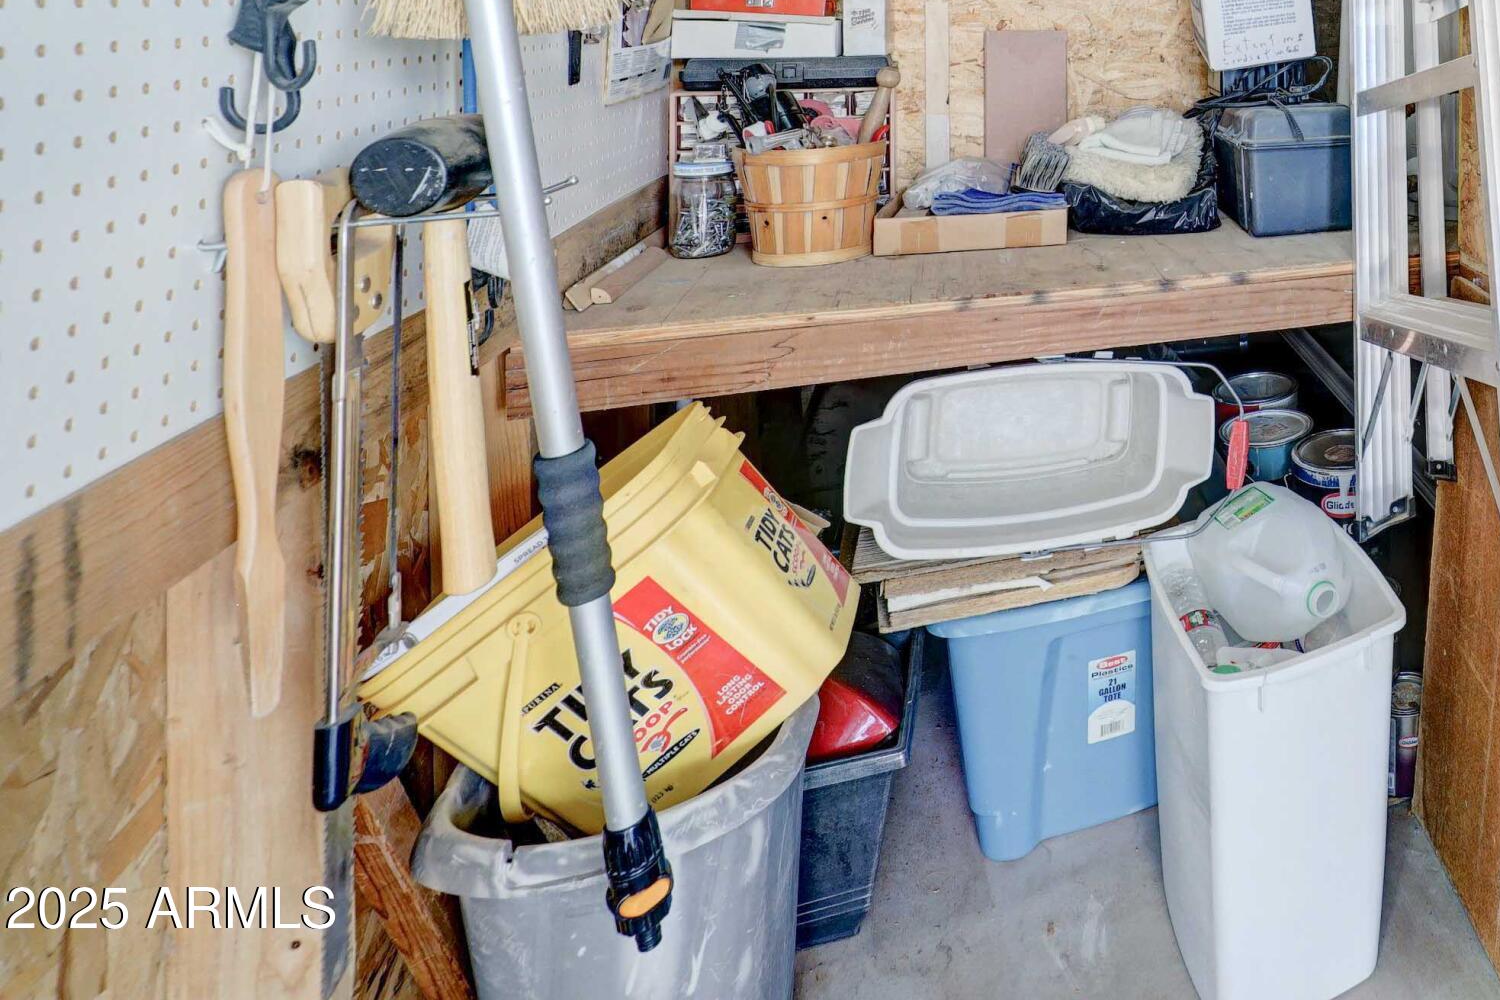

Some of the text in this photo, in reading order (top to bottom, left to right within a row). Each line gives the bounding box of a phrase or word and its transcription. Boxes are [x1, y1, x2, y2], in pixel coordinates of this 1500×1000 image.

[755, 508, 780, 551] TIDY
[773, 524, 795, 573] CATS
[643, 606, 674, 633] TIDY
[665, 623, 698, 651] LOCK
[532, 649, 641, 741] TIY
[716, 673, 752, 705] LASTING
[717, 674, 741, 697] LONG
[728, 682, 753, 705] ODOR
[1099, 683, 1127, 697] GALLON
[1103, 692, 1121, 703] TOTE
[1108, 678, 1117, 687] 21
[523, 683, 560, 713] PURINA
[725, 680, 765, 716] CONTROL
[569, 669, 674, 770] CTS
[646, 731, 698, 774] MULTIPLE CATS
